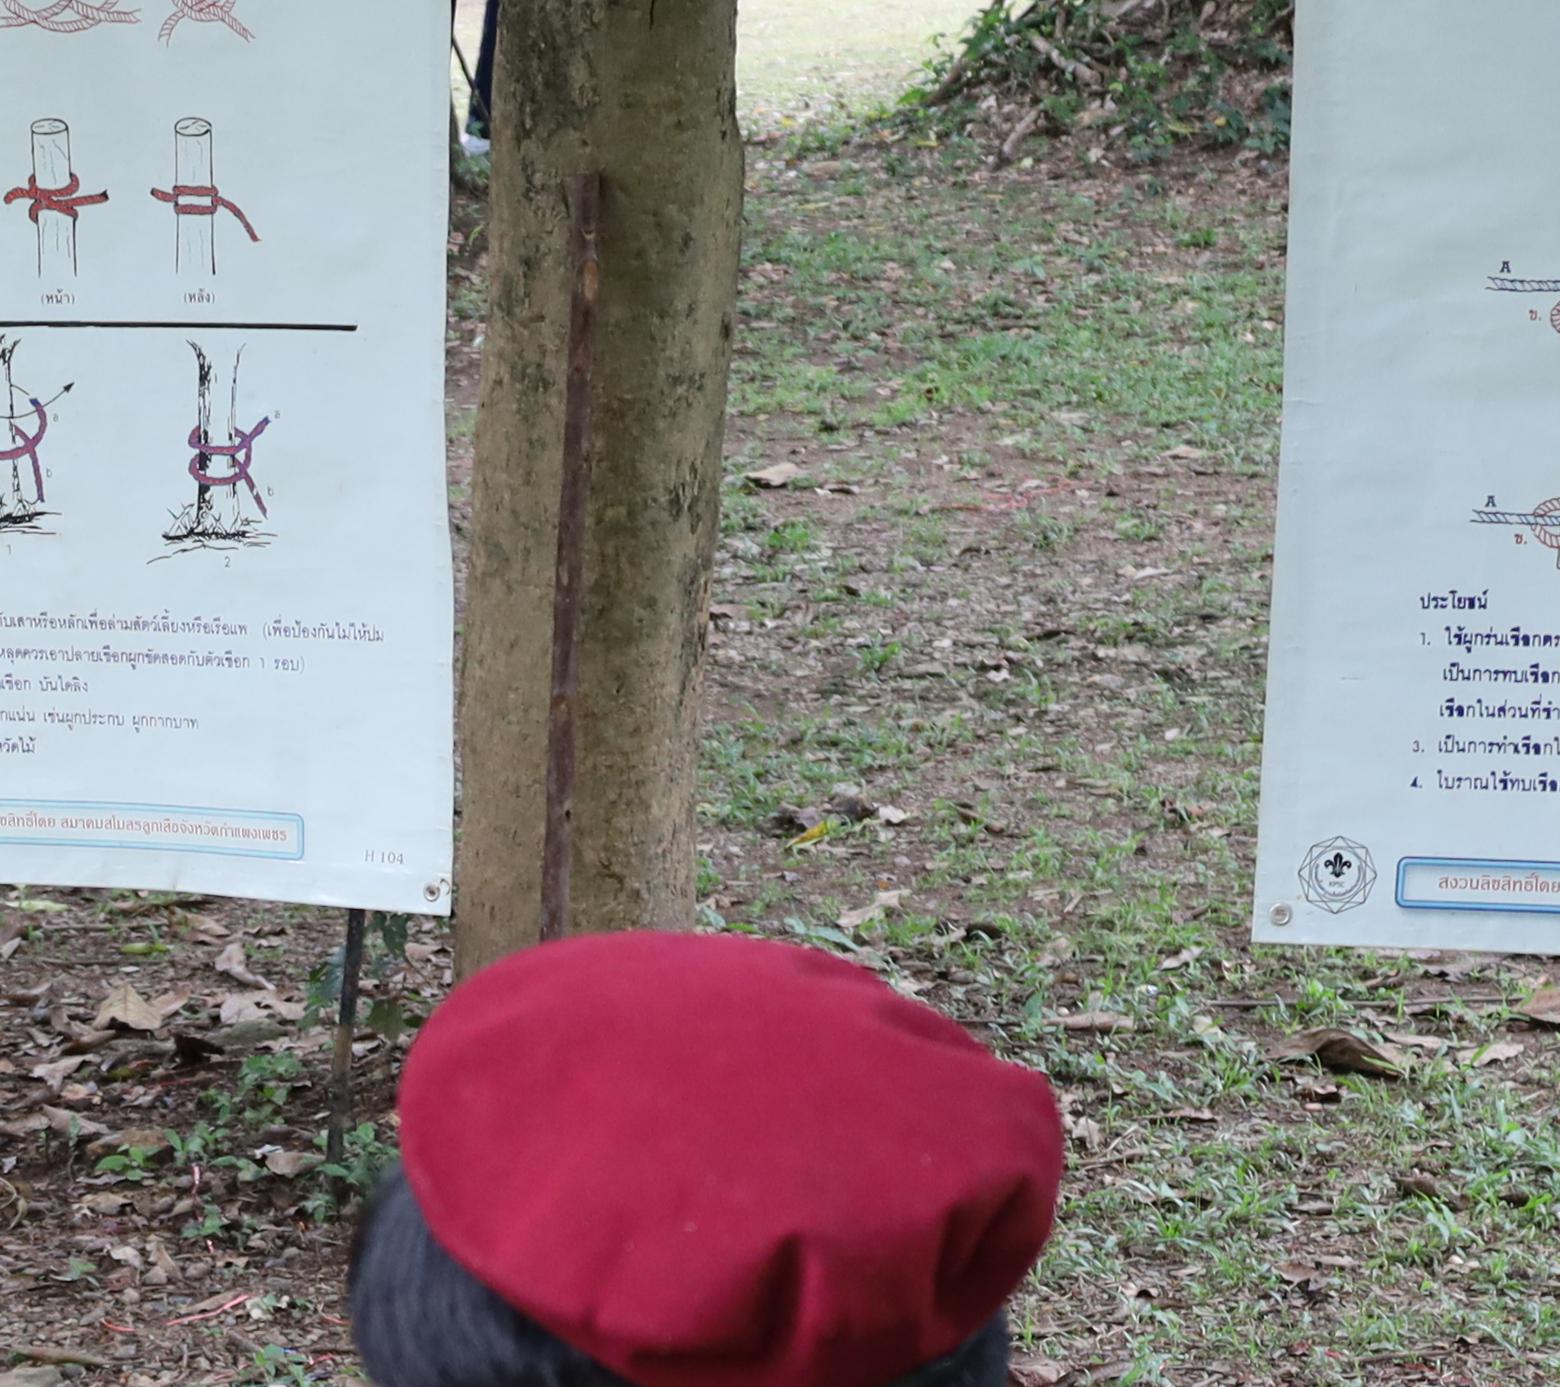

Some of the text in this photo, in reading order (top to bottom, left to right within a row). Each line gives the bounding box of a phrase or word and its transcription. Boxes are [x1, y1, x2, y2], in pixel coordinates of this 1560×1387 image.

[1499, 260, 1511, 273] A
[40, 288, 76, 305] (หน้า)
[183, 287, 216, 305] (หลัง)
[1484, 495, 1497, 508] A
[224, 555, 231, 569] 2
[1420, 589, 1489, 610] ประโยชน์
[274, 656, 304, 673] รอบ)
[39, 675, 88, 692] บันไดลิง
[133, 716, 198, 733] ผูกกากบาท
[1412, 740, 1424, 753] 3.
[60, 812, 288, 842] สมาคมสโมสรลูกเสือจังหวัดกำแพงเพชร
[365, 850, 405, 865] H 104
